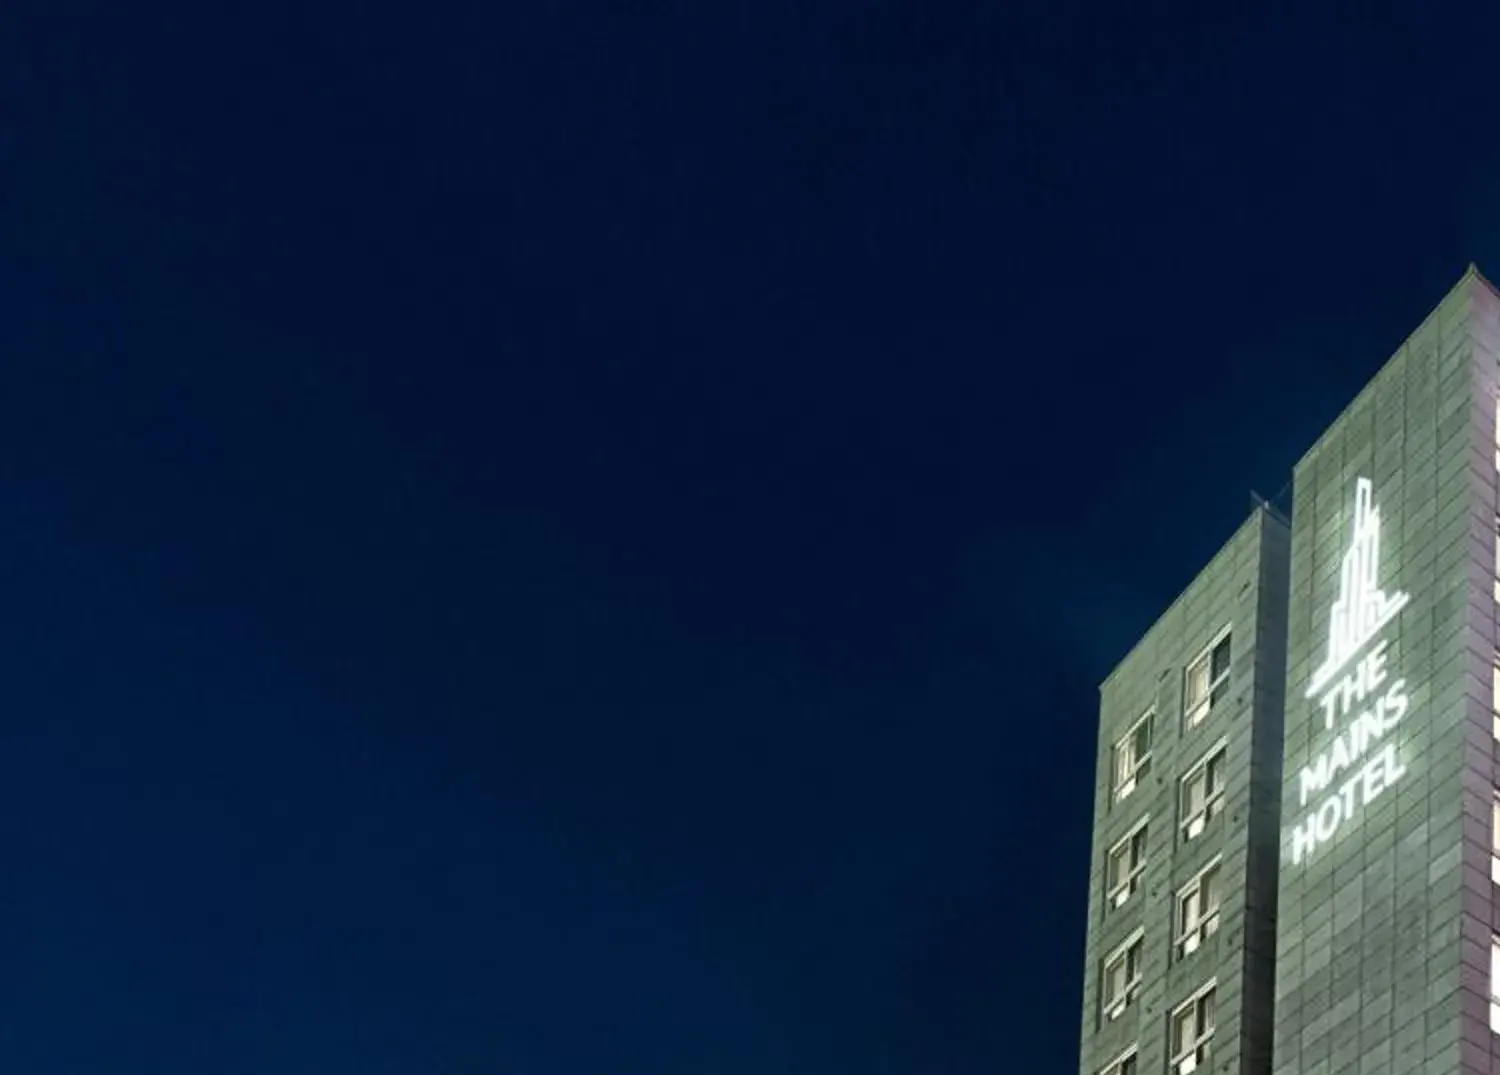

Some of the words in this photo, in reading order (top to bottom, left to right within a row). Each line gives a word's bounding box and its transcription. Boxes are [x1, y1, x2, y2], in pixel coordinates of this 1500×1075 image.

[1301, 678, 1410, 804] MAINS
[1320, 640, 1388, 730] THE
[1292, 743, 1406, 865] HOTEL
